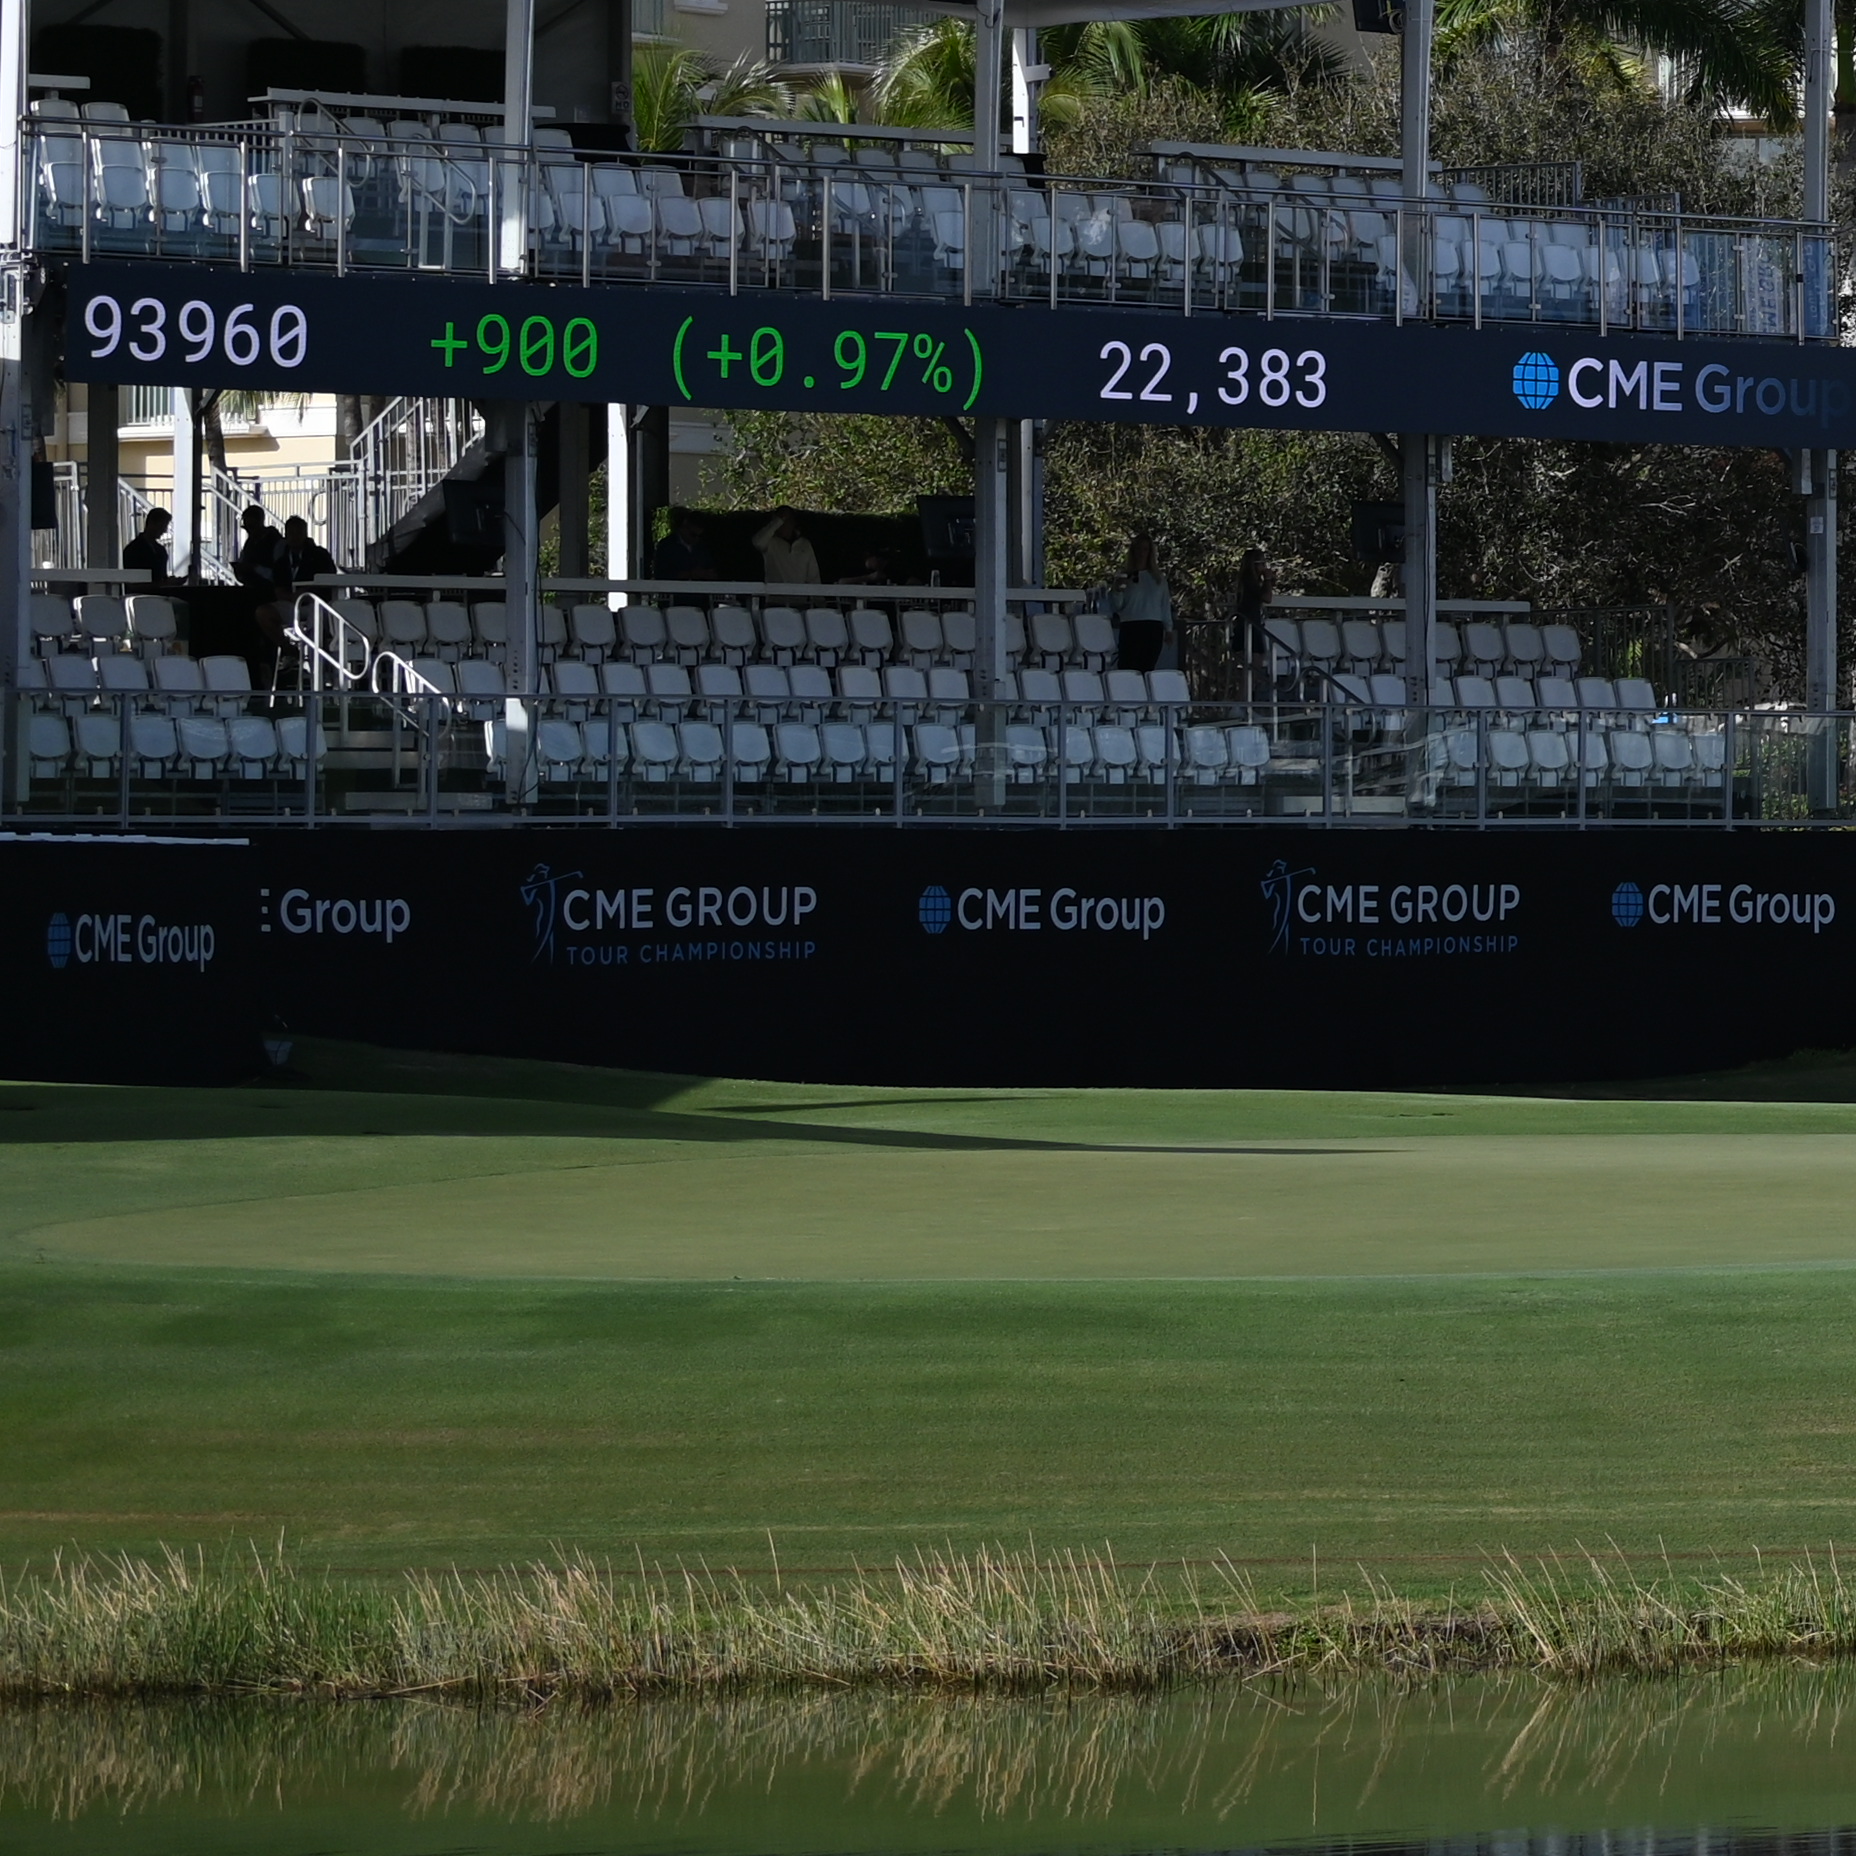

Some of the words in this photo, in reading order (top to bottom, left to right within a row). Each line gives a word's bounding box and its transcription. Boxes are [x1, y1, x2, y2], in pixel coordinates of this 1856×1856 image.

[85, 295, 307, 367] 93960
[431, 314, 597, 377] +900
[674, 316, 982, 411] (+0.97%)
[1100, 341, 1326, 414] 22,383
[1568, 358, 1682, 410] CME
[1695, 363, 1847, 420] Group
[280, 889, 410, 943] Group
[564, 889, 653, 930] CME
[666, 886, 816, 927] GROUP
[958, 888, 1041, 929] CME
[1051, 888, 1164, 940] Group
[1298, 885, 1379, 923] CME
[1391, 885, 1519, 923] GROUP
[1649, 884, 1721, 923] CME
[1729, 884, 1835, 933] Group
[75, 914, 132, 962] CME
[138, 915, 214, 972] Group
[567, 946, 628, 965] TOUR
[640, 942, 815, 963] CHAMPIONSHIP
[1300, 938, 1355, 955] TOUR
[1367, 936, 1518, 956] CHAMPIONSHIP
